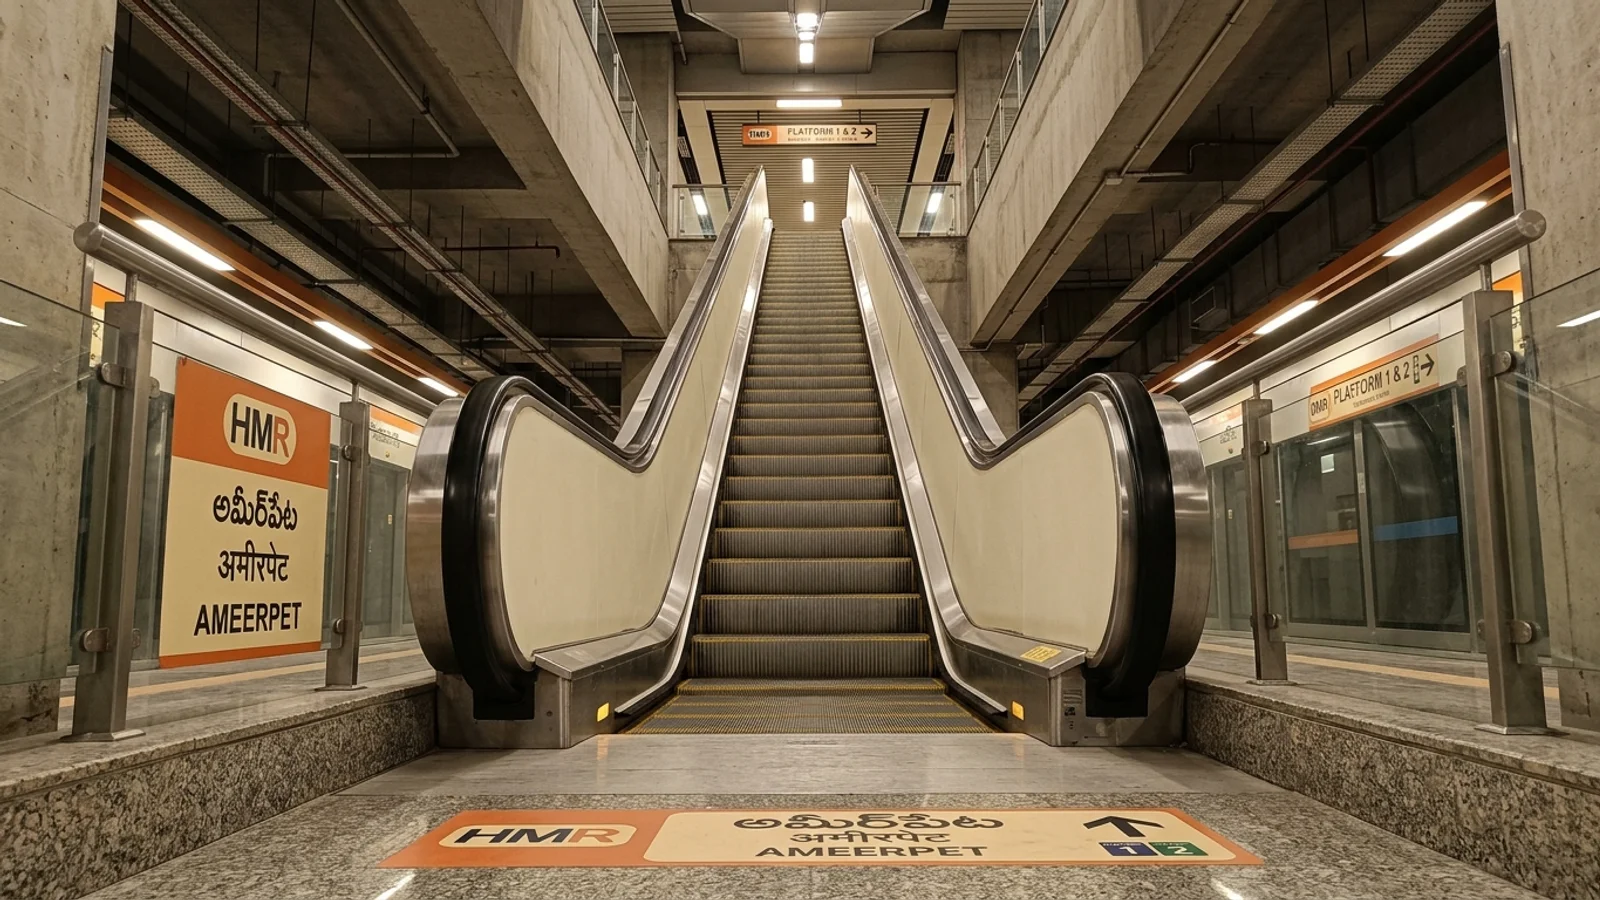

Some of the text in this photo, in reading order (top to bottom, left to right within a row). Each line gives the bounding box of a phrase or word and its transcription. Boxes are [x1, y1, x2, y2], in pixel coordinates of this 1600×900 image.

[851, 127, 857, 135] 2
[1385, 370, 1390, 385] 1
[1393, 365, 1401, 382] &
[1403, 361, 1410, 380] 2
[230, 401, 290, 459] HMR
[217, 539, 290, 582] अमीरपेट
[193, 602, 302, 636] AMEERPET
[453, 828, 622, 843] HMR
[789, 830, 951, 843] अमीरपेट
[755, 846, 988, 856] AMEERPET
[1119, 846, 1138, 855] 1
[1167, 846, 1194, 855] 2
